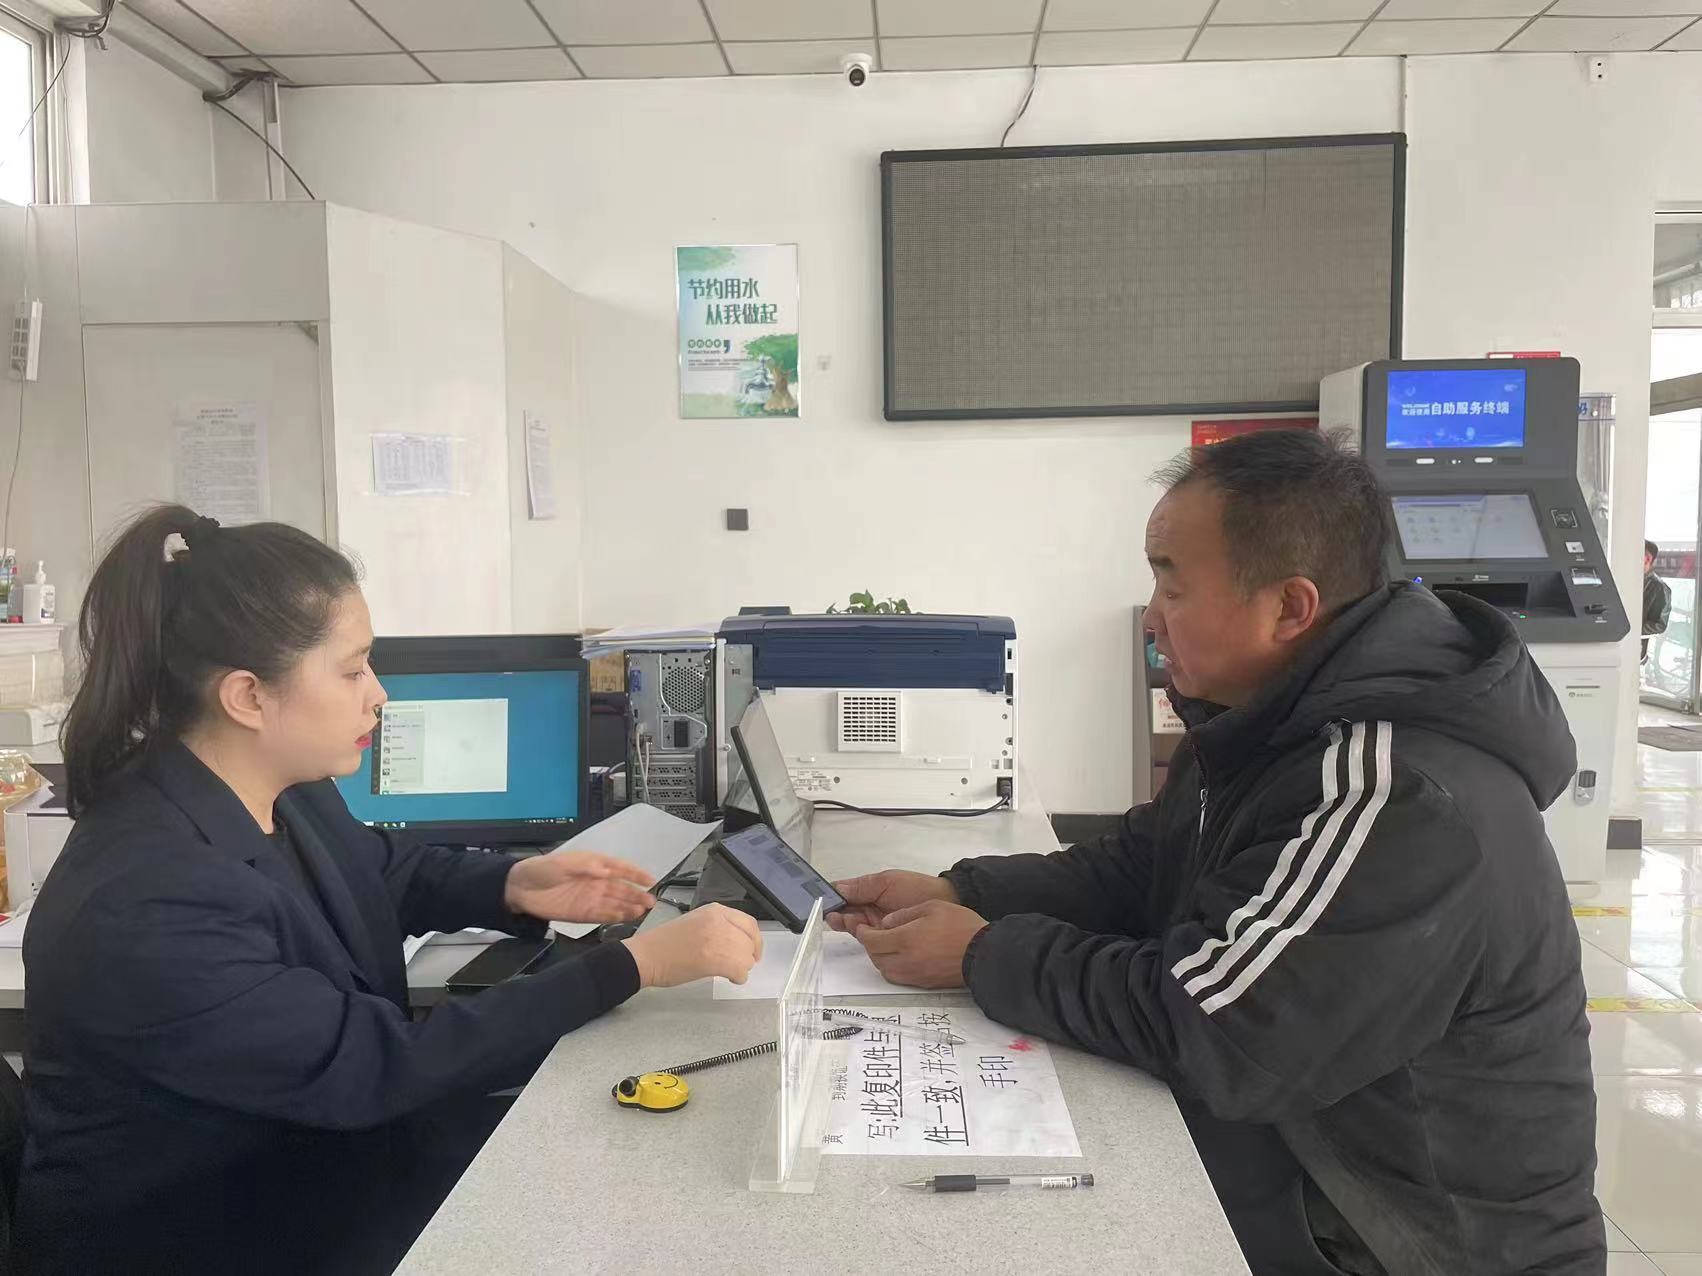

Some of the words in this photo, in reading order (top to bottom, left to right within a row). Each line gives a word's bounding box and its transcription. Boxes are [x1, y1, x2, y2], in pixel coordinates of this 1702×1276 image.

[687, 278, 760, 300] 节约用水
[705, 303, 778, 325] 从我做起
[1431, 401, 1510, 416] 自助服务终端
[918, 1013, 966, 1146] 件一致，并签按
[976, 1055, 1018, 1089] 手印
